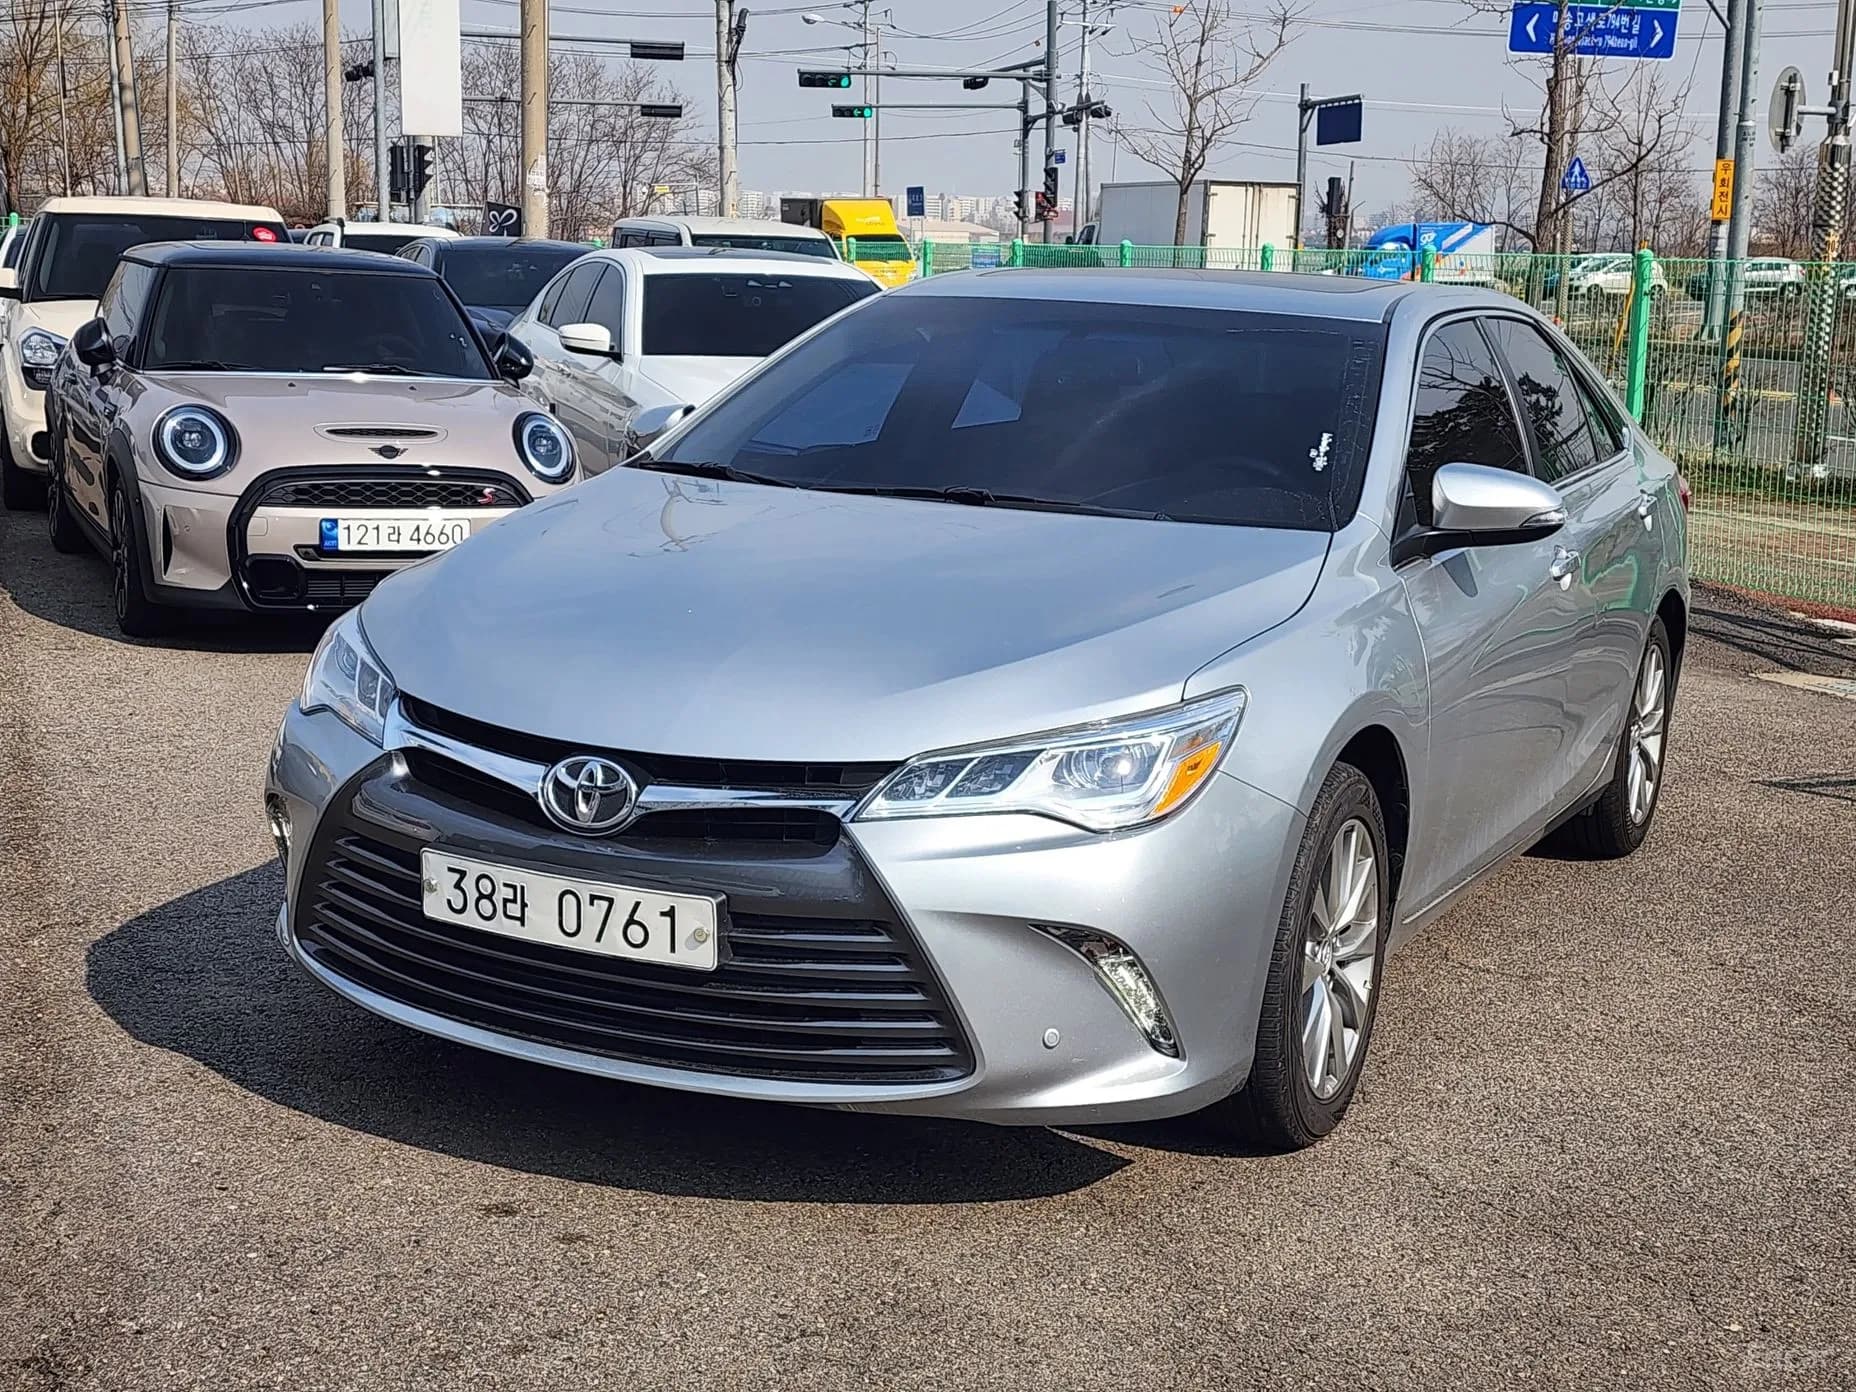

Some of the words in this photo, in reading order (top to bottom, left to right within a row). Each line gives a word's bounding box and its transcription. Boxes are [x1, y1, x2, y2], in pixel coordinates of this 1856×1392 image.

[1717, 163, 1732, 217] 우회전시
[343, 523, 402, 546] 121라
[409, 523, 464, 546] 4660
[446, 866, 529, 928] 38라
[557, 888, 677, 954] 0761
